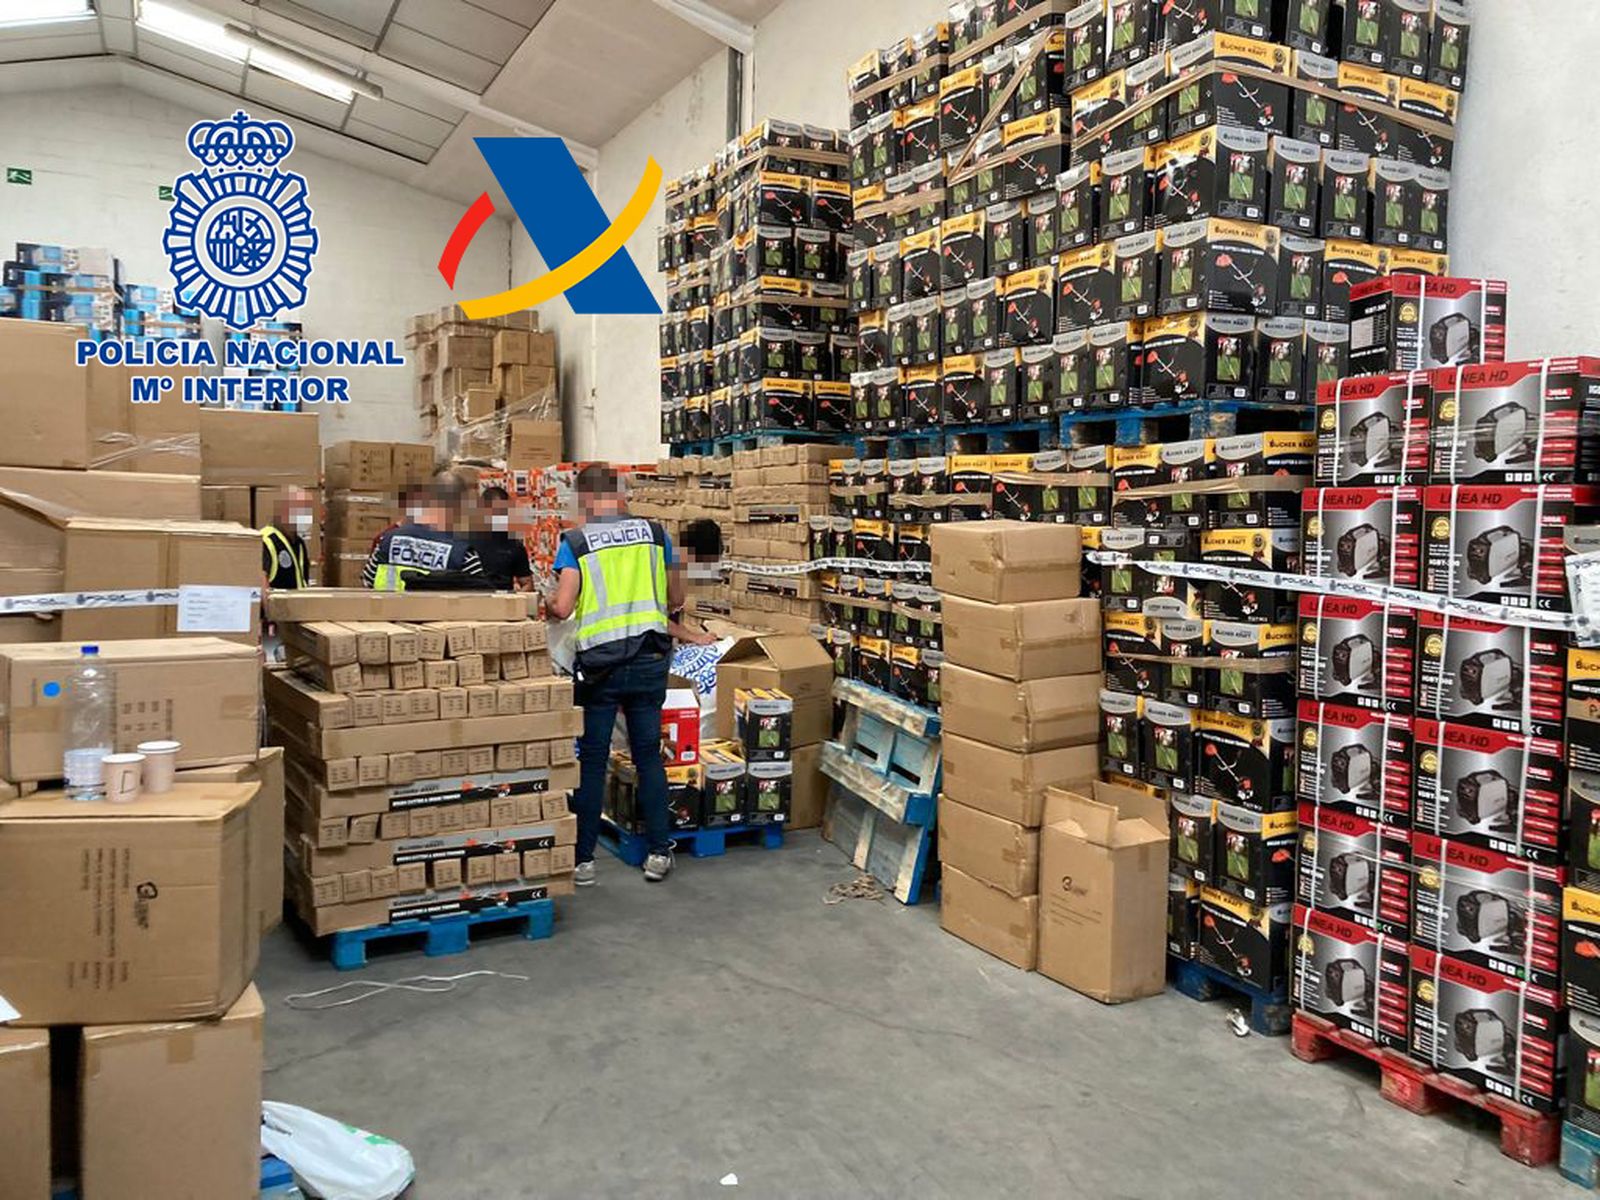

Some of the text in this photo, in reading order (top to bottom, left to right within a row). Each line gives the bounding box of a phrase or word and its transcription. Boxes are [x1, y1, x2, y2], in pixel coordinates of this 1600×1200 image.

[1441, 282, 1456, 294] HD
[1448, 370, 1509, 384] LNEA HD
[1359, 383, 1374, 393] HD
[1313, 494, 1363, 506] LNEA HD
[1482, 493, 1502, 504] HD
[588, 527, 651, 548] POLICIA
[392, 546, 444, 568] POLICIA
[1342, 604, 1358, 614] HD
[1428, 728, 1489, 747] LIEA HD
[532, 782, 544, 790] CE
[538, 840, 549, 848] CE
[1470, 854, 1488, 866] HD
[1336, 924, 1352, 938] HD
[1467, 972, 1487, 986] HD
